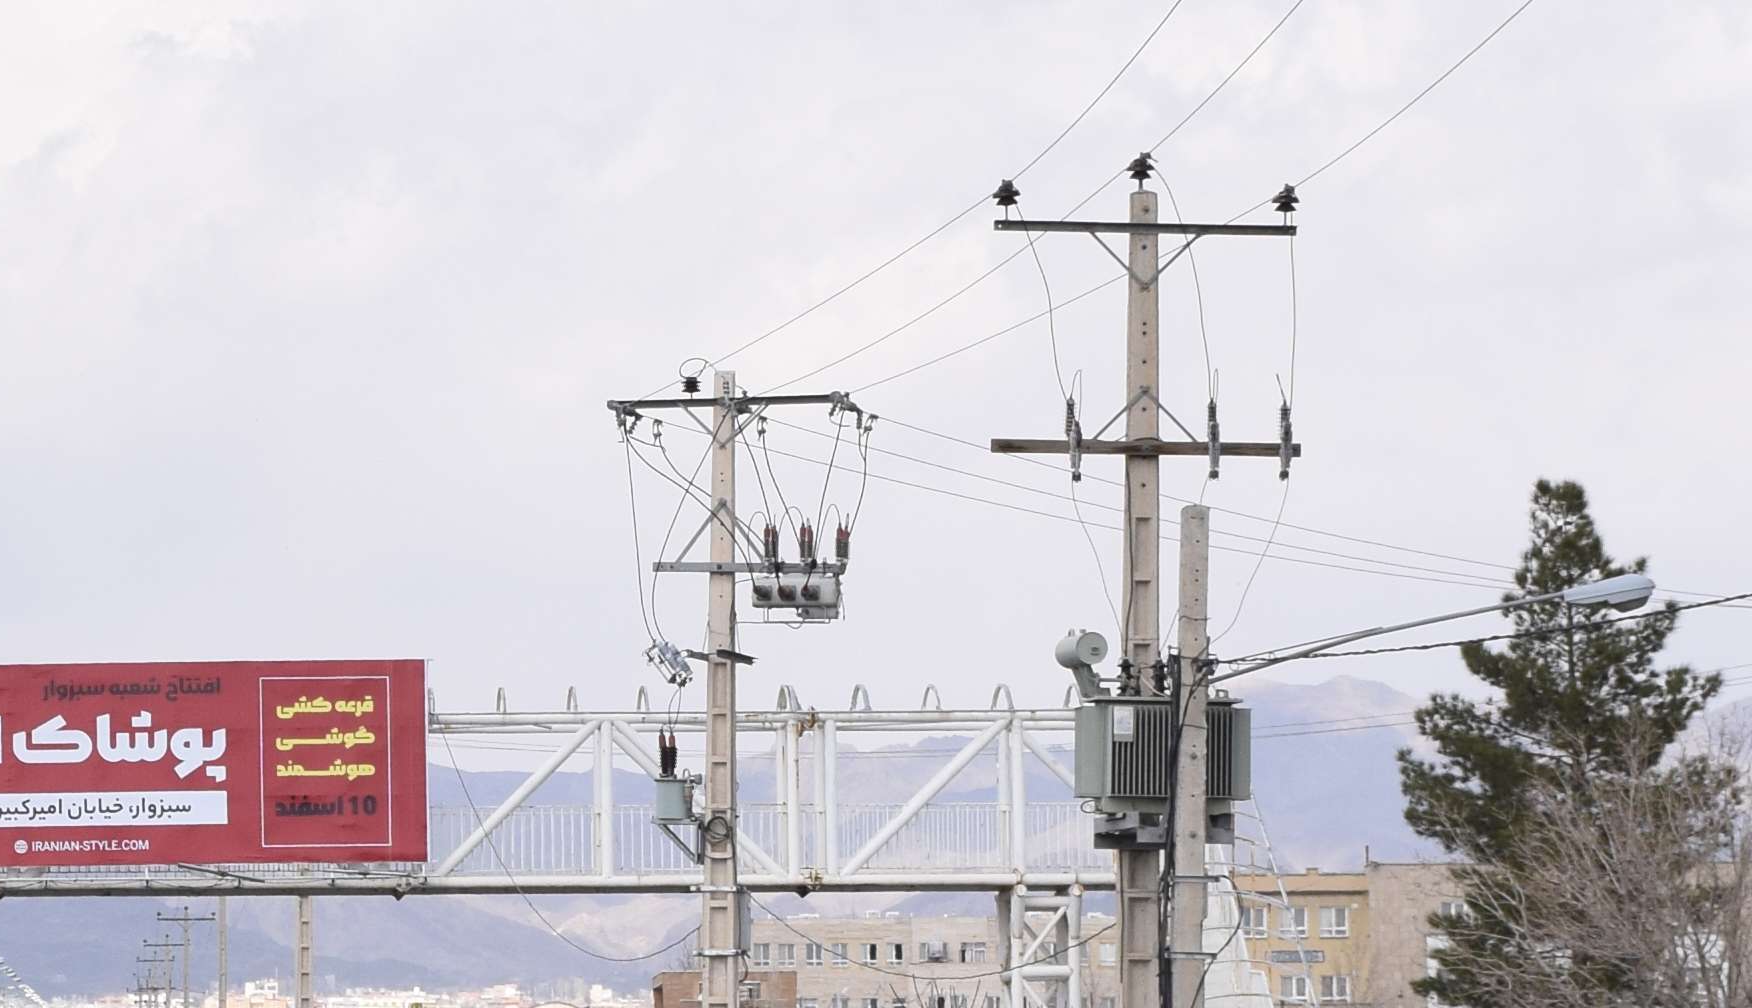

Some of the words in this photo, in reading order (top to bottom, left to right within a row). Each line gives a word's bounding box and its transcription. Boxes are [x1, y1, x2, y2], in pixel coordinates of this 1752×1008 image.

[42, 679, 105, 701] سبزوار
[108, 677, 161, 700] شعبه
[165, 675, 221, 701] افتتاح
[276, 695, 333, 719] کشی
[334, 695, 374, 717] قرعه
[12, 710, 227, 783] پوشاک
[275, 725, 376, 751] گوشی
[276, 758, 376, 781] هوشمند
[68, 798, 124, 820] خیابان
[129, 797, 192, 818] سبزوار،
[275, 794, 345, 816] اسفند
[31, 839, 149, 853] IRANIAN-STYLE.COM
